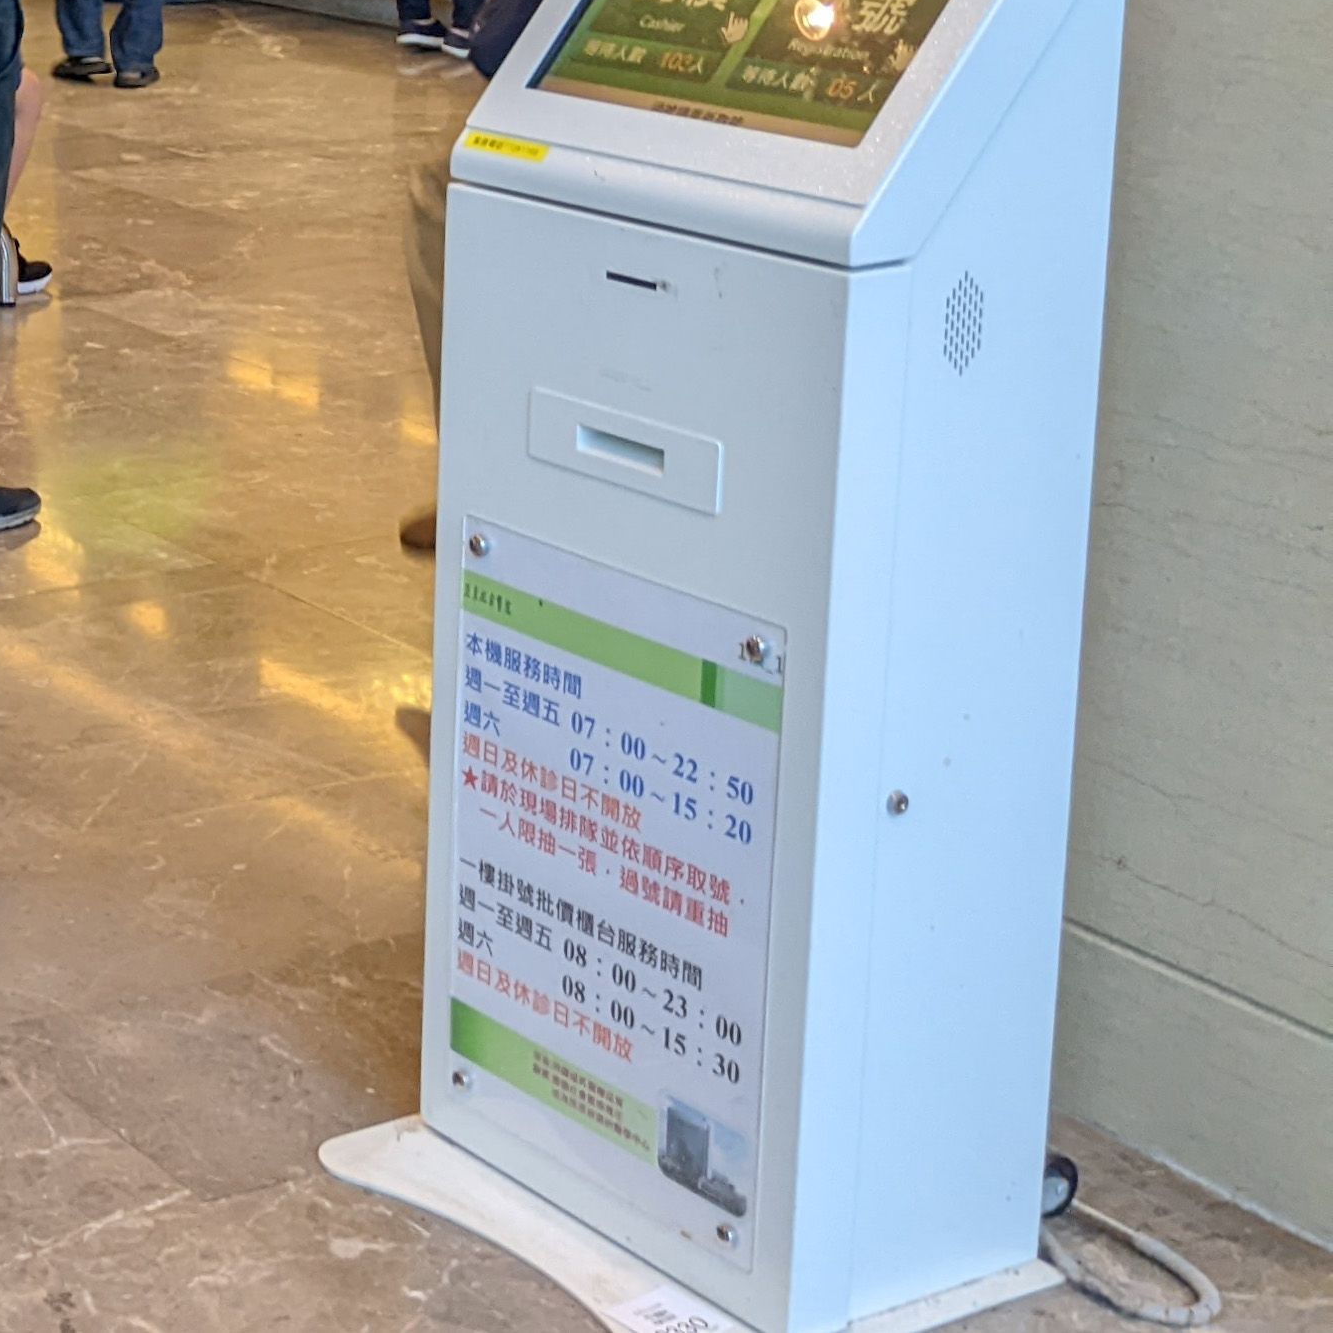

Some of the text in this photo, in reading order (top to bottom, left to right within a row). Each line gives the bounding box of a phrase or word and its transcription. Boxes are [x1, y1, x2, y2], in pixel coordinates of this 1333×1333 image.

[464, 665, 560, 728] 週一至週五
[465, 631, 582, 700] 本機服務時間
[464, 699, 501, 738] 週六
[462, 730, 642, 833] 週日及休診日不開放
[457, 917, 494, 957] 週六
[459, 883, 553, 953] 週一至週五
[459, 856, 703, 992] 一樓掛號批價櫃台服務時間
[456, 947, 634, 1065] 週日及休診日不開放
